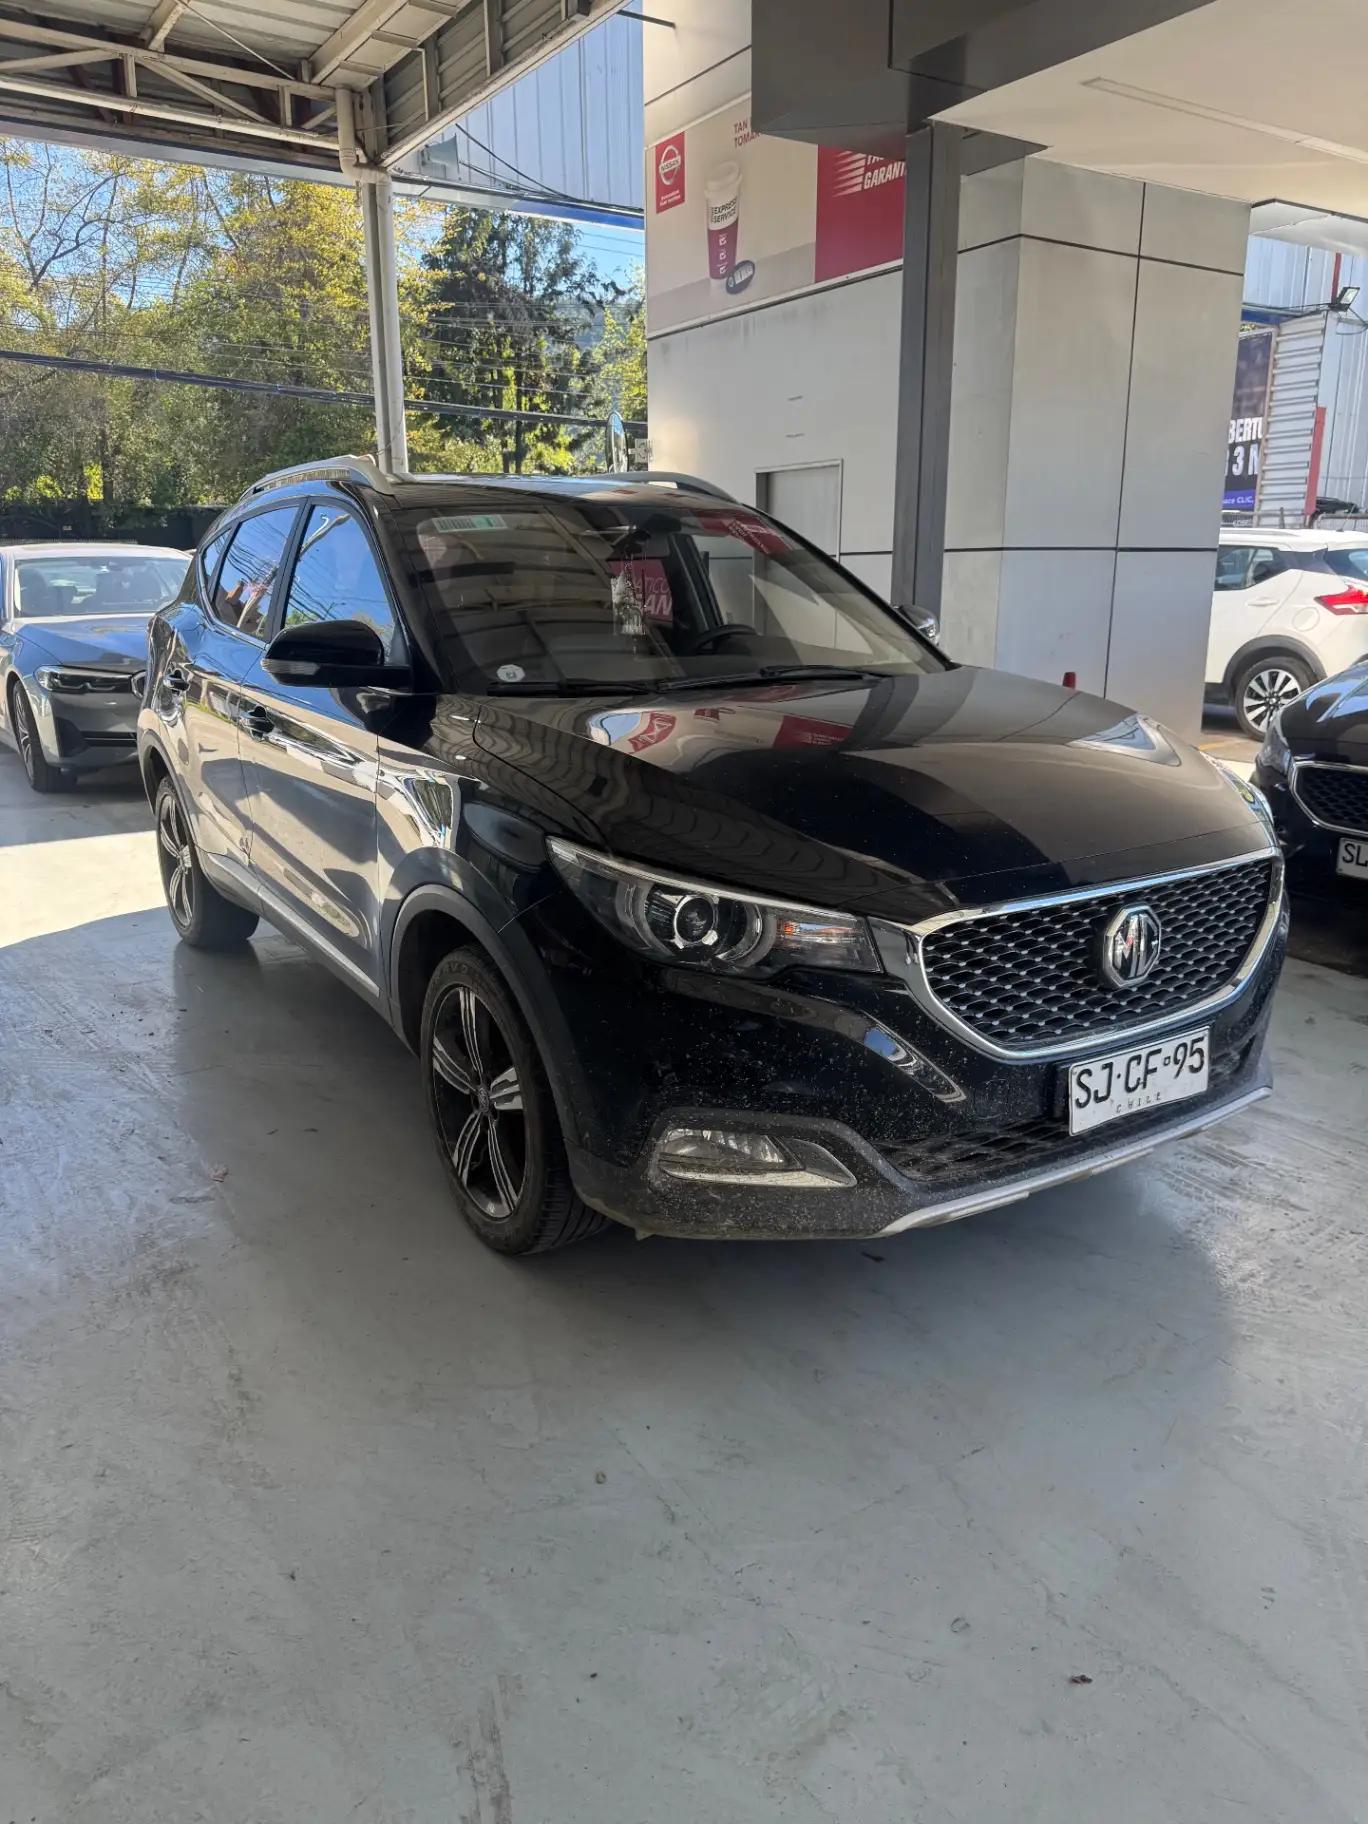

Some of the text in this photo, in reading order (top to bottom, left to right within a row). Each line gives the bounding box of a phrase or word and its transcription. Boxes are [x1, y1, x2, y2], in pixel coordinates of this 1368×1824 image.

[734, 120, 748, 134] TAN
[864, 161, 907, 189] GARANT
[1115, 1091, 1163, 1114] CHILE
